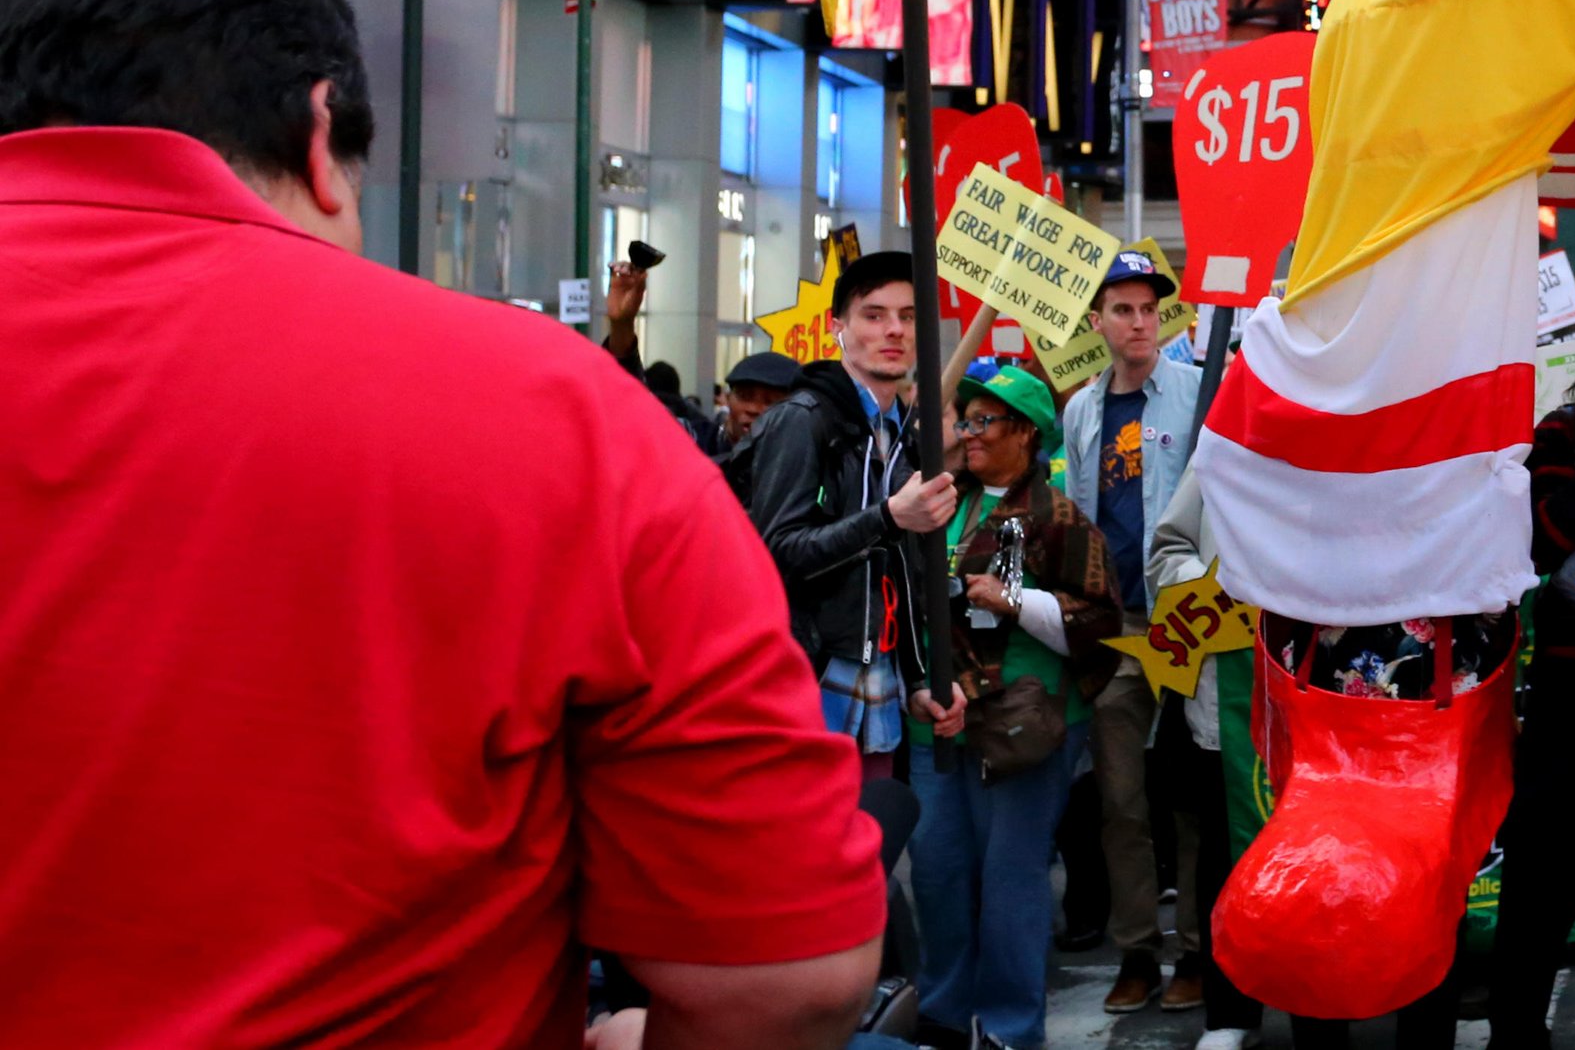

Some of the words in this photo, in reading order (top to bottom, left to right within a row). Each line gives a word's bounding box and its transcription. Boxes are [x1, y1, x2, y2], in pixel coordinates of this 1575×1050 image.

[1194, 76, 1304, 166] $15
[953, 210, 1014, 256] GREAT
[1012, 241, 1070, 288] WORK
[966, 178, 1006, 214] FAIR
[1015, 203, 1064, 245] WAGE
[1068, 234, 1104, 269] FOR
[937, 245, 992, 285] SUPPORT
[990, 275, 1010, 296] $15
[1007, 288, 1032, 308] AN
[1032, 299, 1070, 332] HOUR
[1159, 303, 1188, 326] OUR
[1052, 345, 1107, 380] SUPPORT
[1148, 592, 1221, 667] $15
